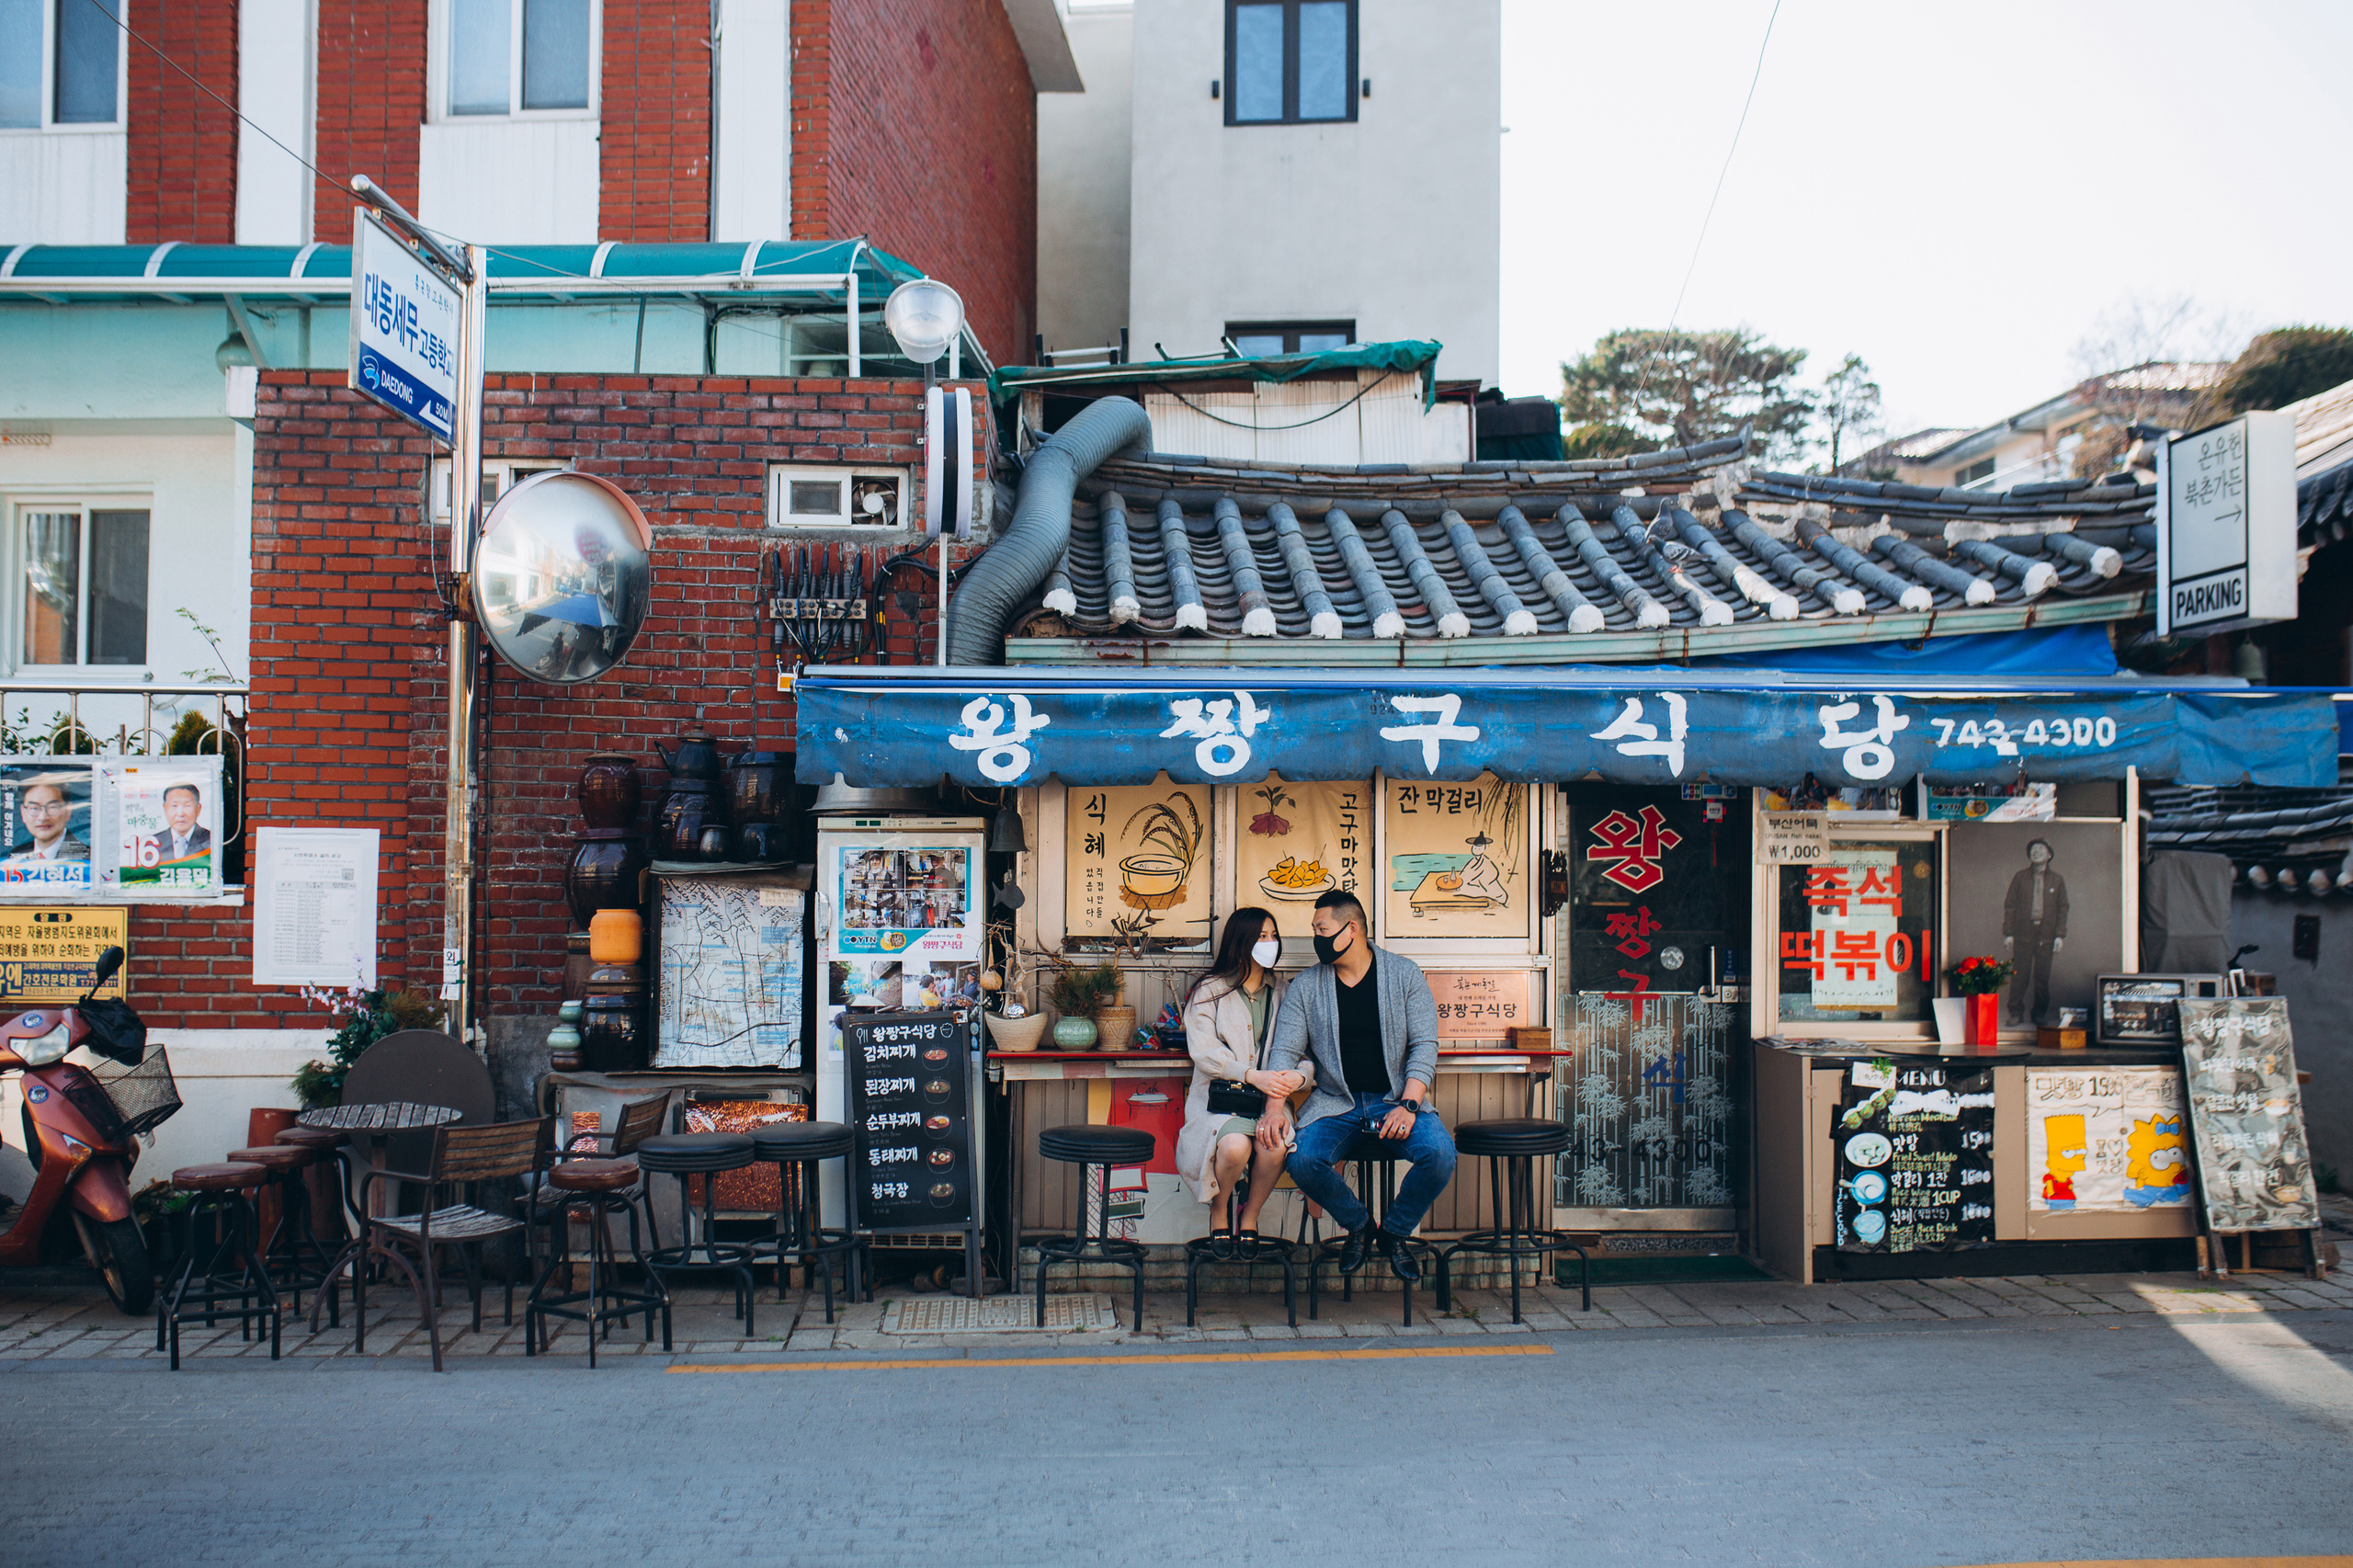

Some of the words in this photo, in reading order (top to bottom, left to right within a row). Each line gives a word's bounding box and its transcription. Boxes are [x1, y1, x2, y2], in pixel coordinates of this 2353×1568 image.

[364, 272, 454, 380] 대동세무고등학교
[381, 369, 413, 404] DAEDONG
[2185, 467, 2243, 508] 북촌가든
[2177, 578, 2241, 619] PARKING
[1398, 785, 1420, 814] 잔
[1426, 786, 1483, 815] 막걸리
[1084, 793, 1107, 860] 식혜
[1769, 818, 1818, 830] 부산어묵
[124, 835, 162, 869] 16
[1802, 866, 1903, 917] 즉석
[858, 936, 877, 944] YTN
[1780, 929, 1930, 982] 떡볶이
[1437, 1003, 1518, 1018] 왕짱구식당
[872, 1024, 938, 1043] 왕짱구식당
[863, 1043, 916, 1062] 김치찌개
[865, 1077, 915, 1096] 된장찌개
[1895, 1070, 1947, 1086] MENU
[866, 1111, 921, 1131] 순두부찌개
[1892, 1132, 1919, 1153] 맛탕
[869, 1146, 918, 1166] 동태찌개
[1891, 1170, 1923, 1188] 막걸리
[871, 1182, 909, 1199] 청국장
